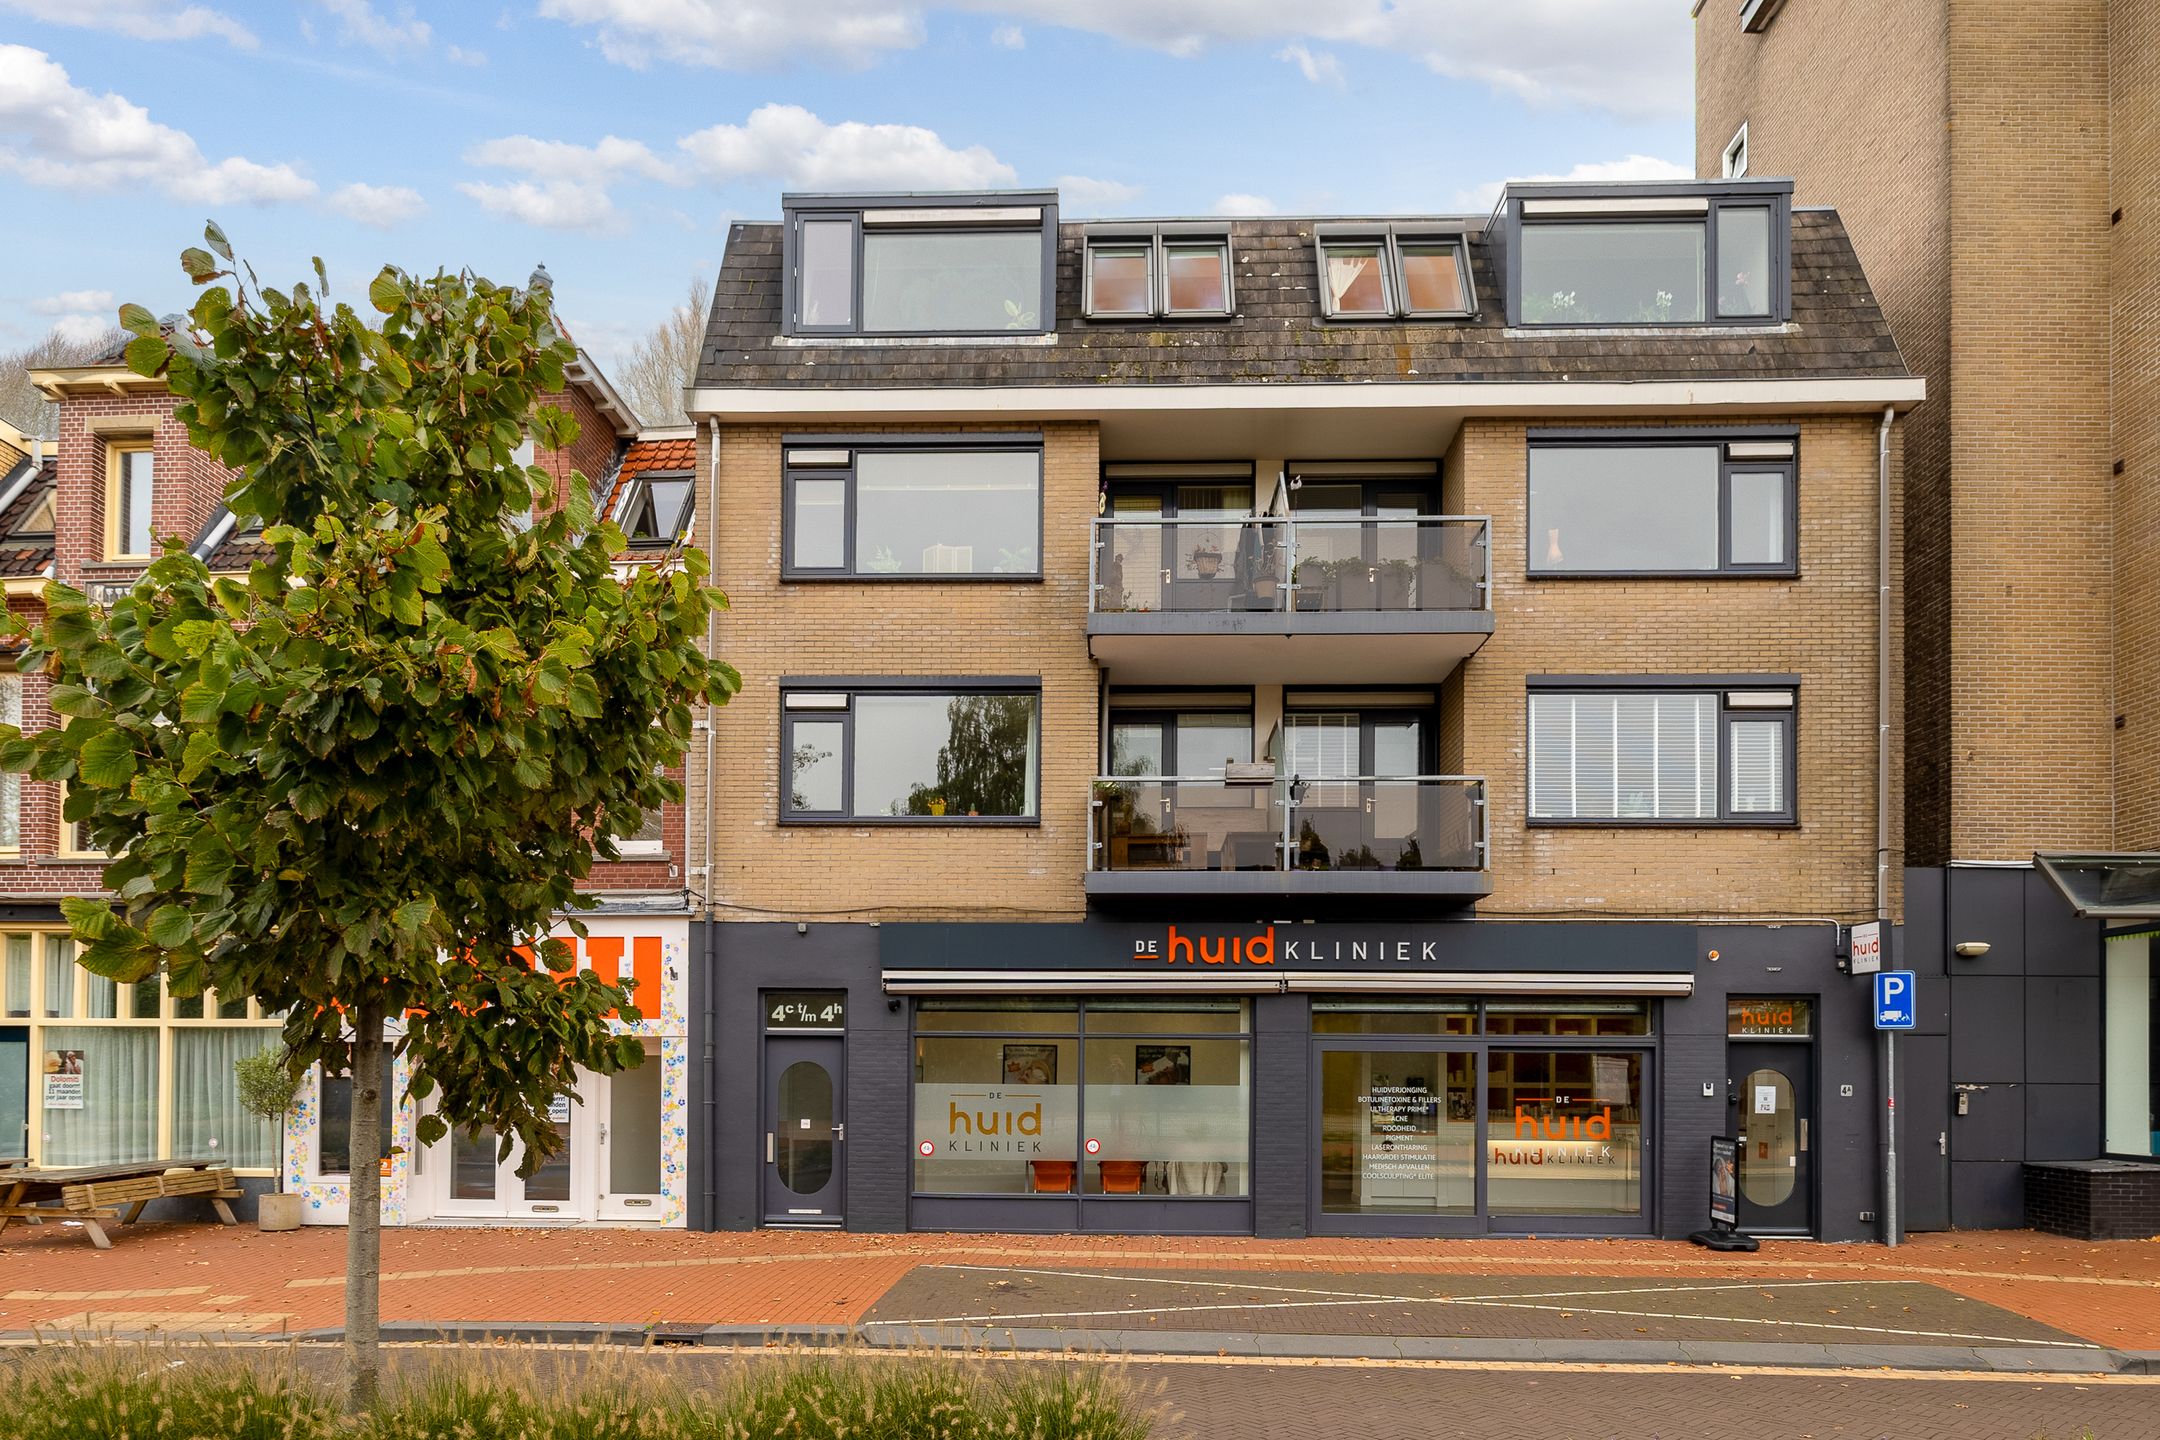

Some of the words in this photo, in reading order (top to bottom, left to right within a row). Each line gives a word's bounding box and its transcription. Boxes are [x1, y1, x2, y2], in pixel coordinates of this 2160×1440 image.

[1136, 940, 1157, 952] DE
[1168, 925, 1275, 965] huid
[1285, 941, 1437, 961] KLINIEK
[1853, 937, 1879, 956] huid
[1884, 977, 1905, 1005] P
[797, 1003, 817, 1022] t/m
[820, 1003, 843, 1022] 4h
[1742, 1007, 1793, 1025] huid
[1841, 1086, 1852, 1096] 4A
[949, 1102, 1042, 1136] huid
[1515, 1106, 1611, 1140] huid
[949, 1141, 1041, 1152] KLINIEK
[1495, 1147, 1543, 1165] huid
[1547, 1155, 1616, 1164] KLINIEK
[1516, 1146, 1611, 1157] KLINIEK
